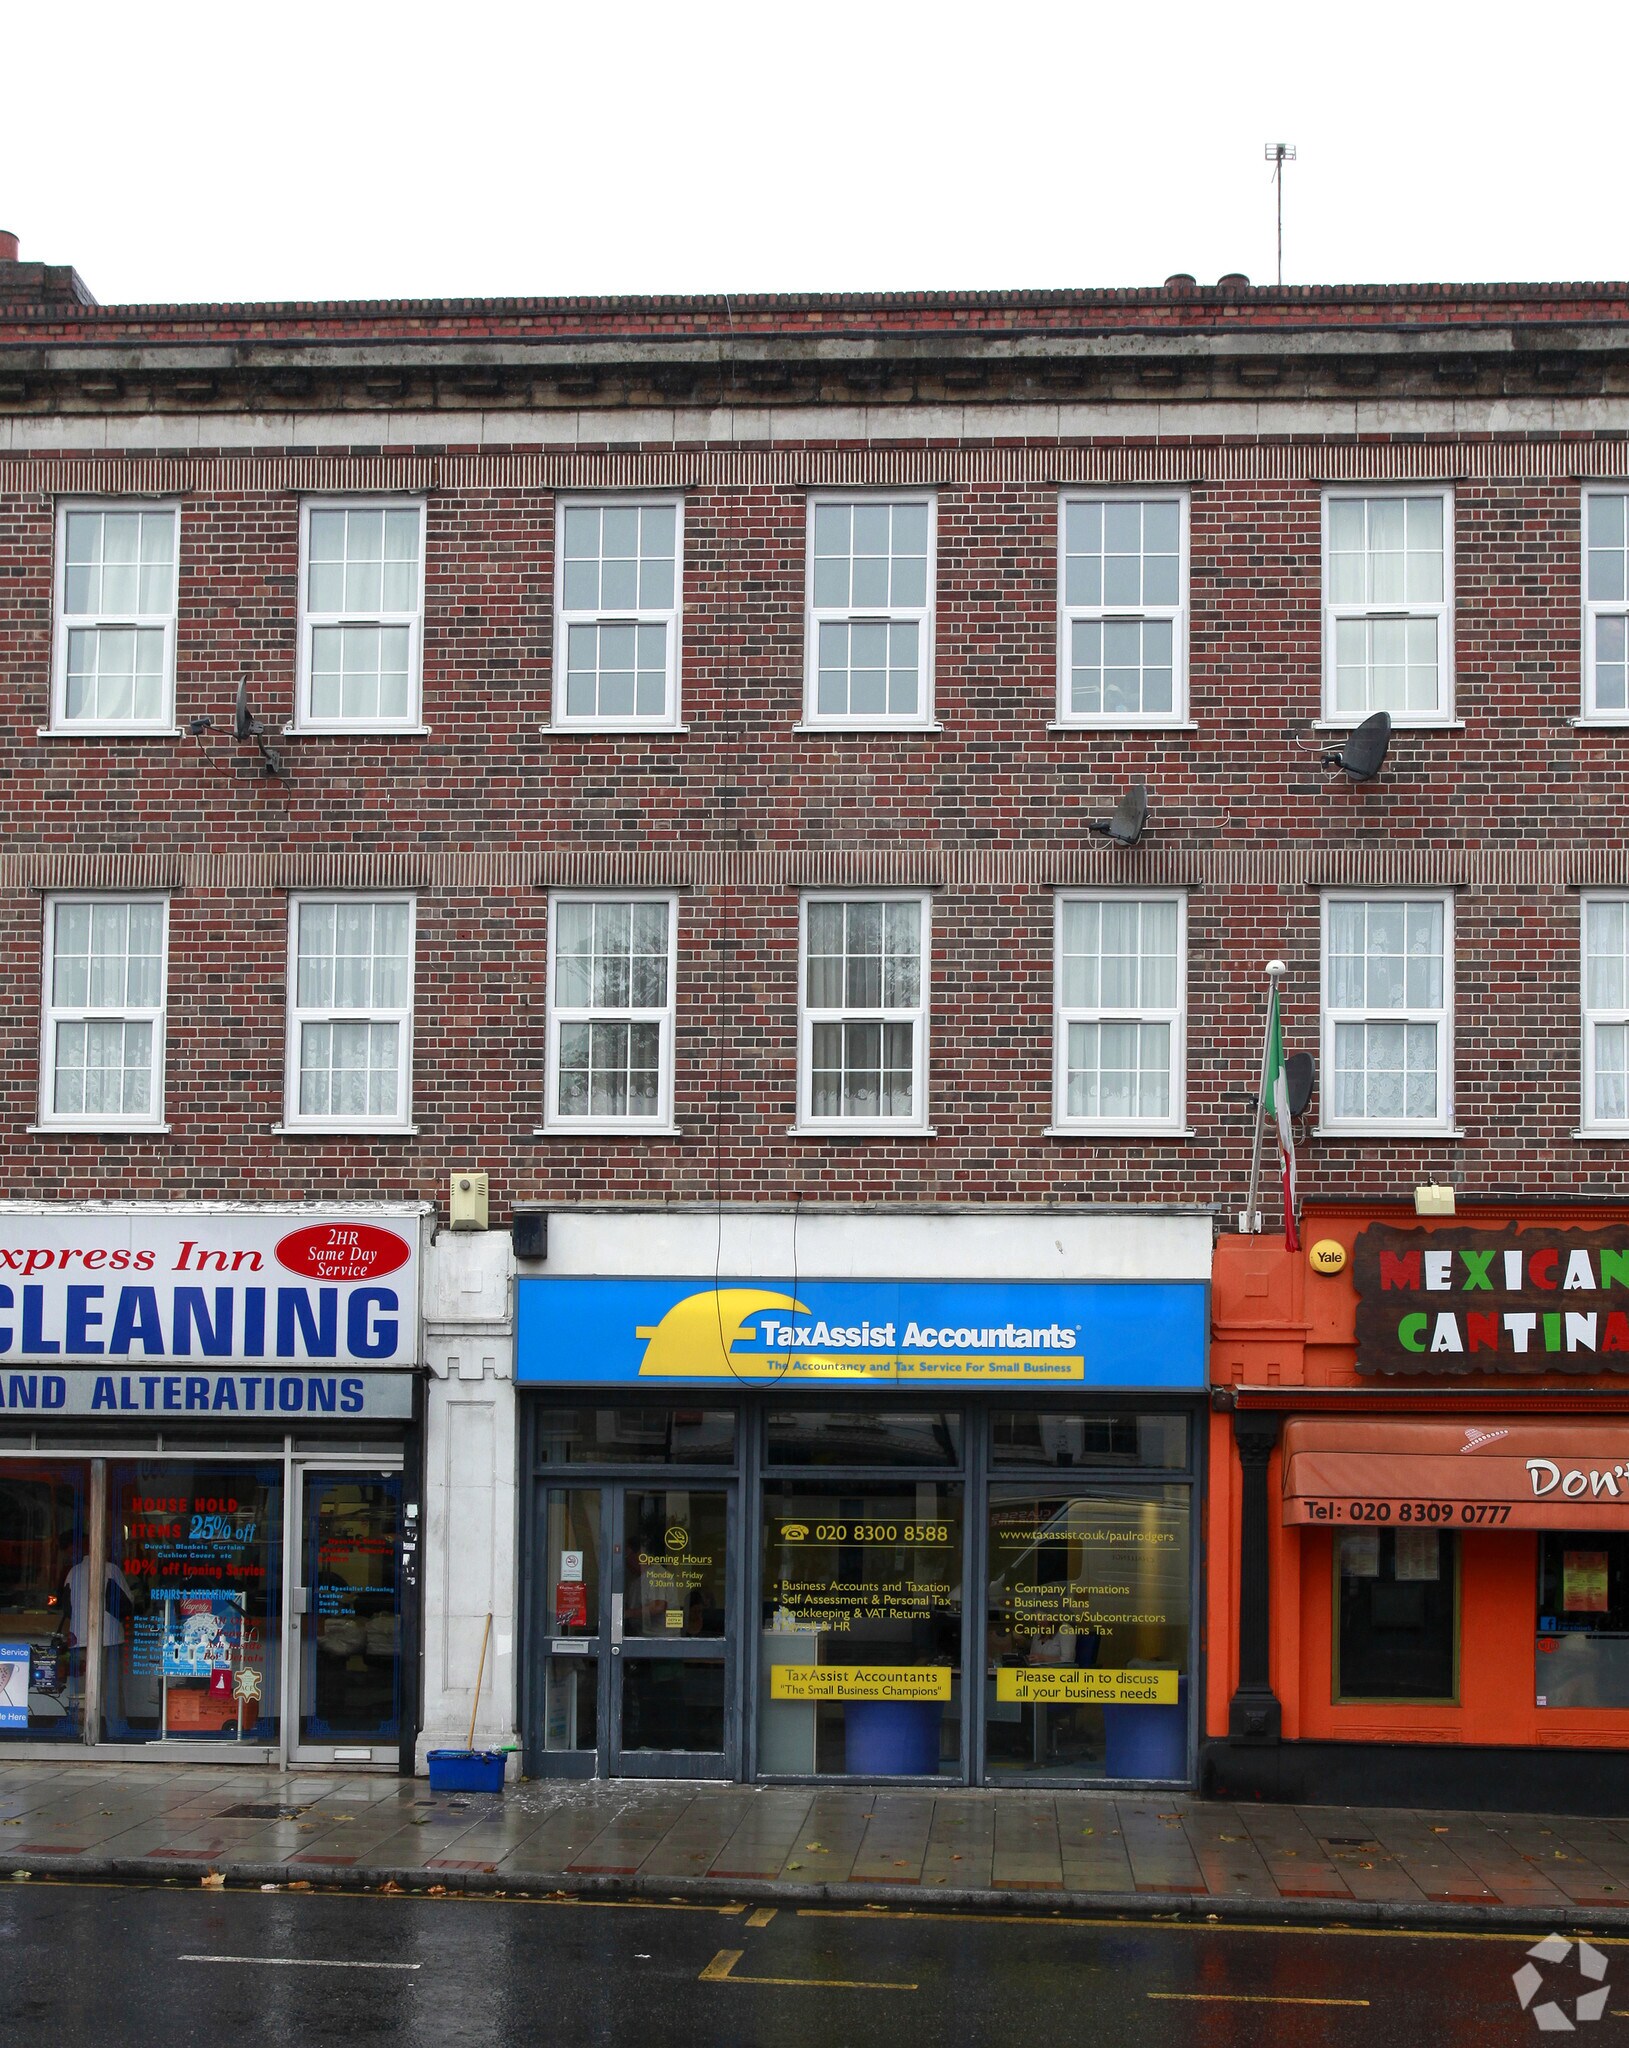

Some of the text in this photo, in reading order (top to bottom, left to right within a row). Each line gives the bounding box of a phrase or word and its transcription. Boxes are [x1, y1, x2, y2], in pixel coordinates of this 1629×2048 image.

[327, 1228, 359, 1246] 2HR
[172, 1241, 264, 1272] Inn
[308, 1246, 378, 1266] Same Day
[1317, 1251, 1343, 1263] Yale
[317, 1260, 369, 1277] Service
[1379, 1249, 1629, 1290] MEXICAN
[760, 1320, 1077, 1349] TaxAssist Accountants
[1397, 1311, 1629, 1353] CANTINA
[767, 1360, 1072, 1374] The Accountancy and Tax Service For Small Business
[0, 1375, 364, 1412] ND ALTERATIONS
[132, 1497, 238, 1513] HOUSE HOLD
[1304, 1501, 1512, 1524] Tel: 020 8309 0777
[131, 1514, 257, 1543] ITEMS 25% off
[816, 1525, 948, 1541] 020 8300 8588
[1000, 1530, 1175, 1543] www.taxassist.co.uk/paulrodgers
[144, 1543, 170, 1551] Duvets
[175, 1543, 208, 1551] Blankets
[638, 1553, 713, 1566] Opening Hours
[123, 1559, 266, 1579] 10% off Ironing Service
[646, 1571, 675, 1580] Monday
[682, 1571, 704, 1580] Friday
[676, 1580, 684, 1588] to
[686, 1580, 702, 1589] 5pm
[782, 1580, 950, 1592] Business Accounts and Taxation
[1014, 1583, 1130, 1596] Company Formations
[150, 1589, 236, 1600] REPAIRS & ALTERATIONS
[782, 1594, 951, 1606] Self Assessment & Personal Tax
[1014, 1597, 1090, 1608] Business Plans
[781, 1608, 931, 1621] Bookkeeping & VAT Returns
[1014, 1610, 1166, 1623] Contractors/Subcontractors
[833, 1622, 851, 1632] HR
[1014, 1624, 1113, 1636] Capital Gains Tax
[1, 1648, 29, 1656] Service
[785, 1669, 938, 1683] TaxAssist Accountants
[1016, 1670, 1159, 1685] Please call in to discuss
[780, 1685, 942, 1698] "The Small Business Champions"
[1015, 1685, 1157, 1700] all your business needs
[8, 1713, 27, 1721] Here
